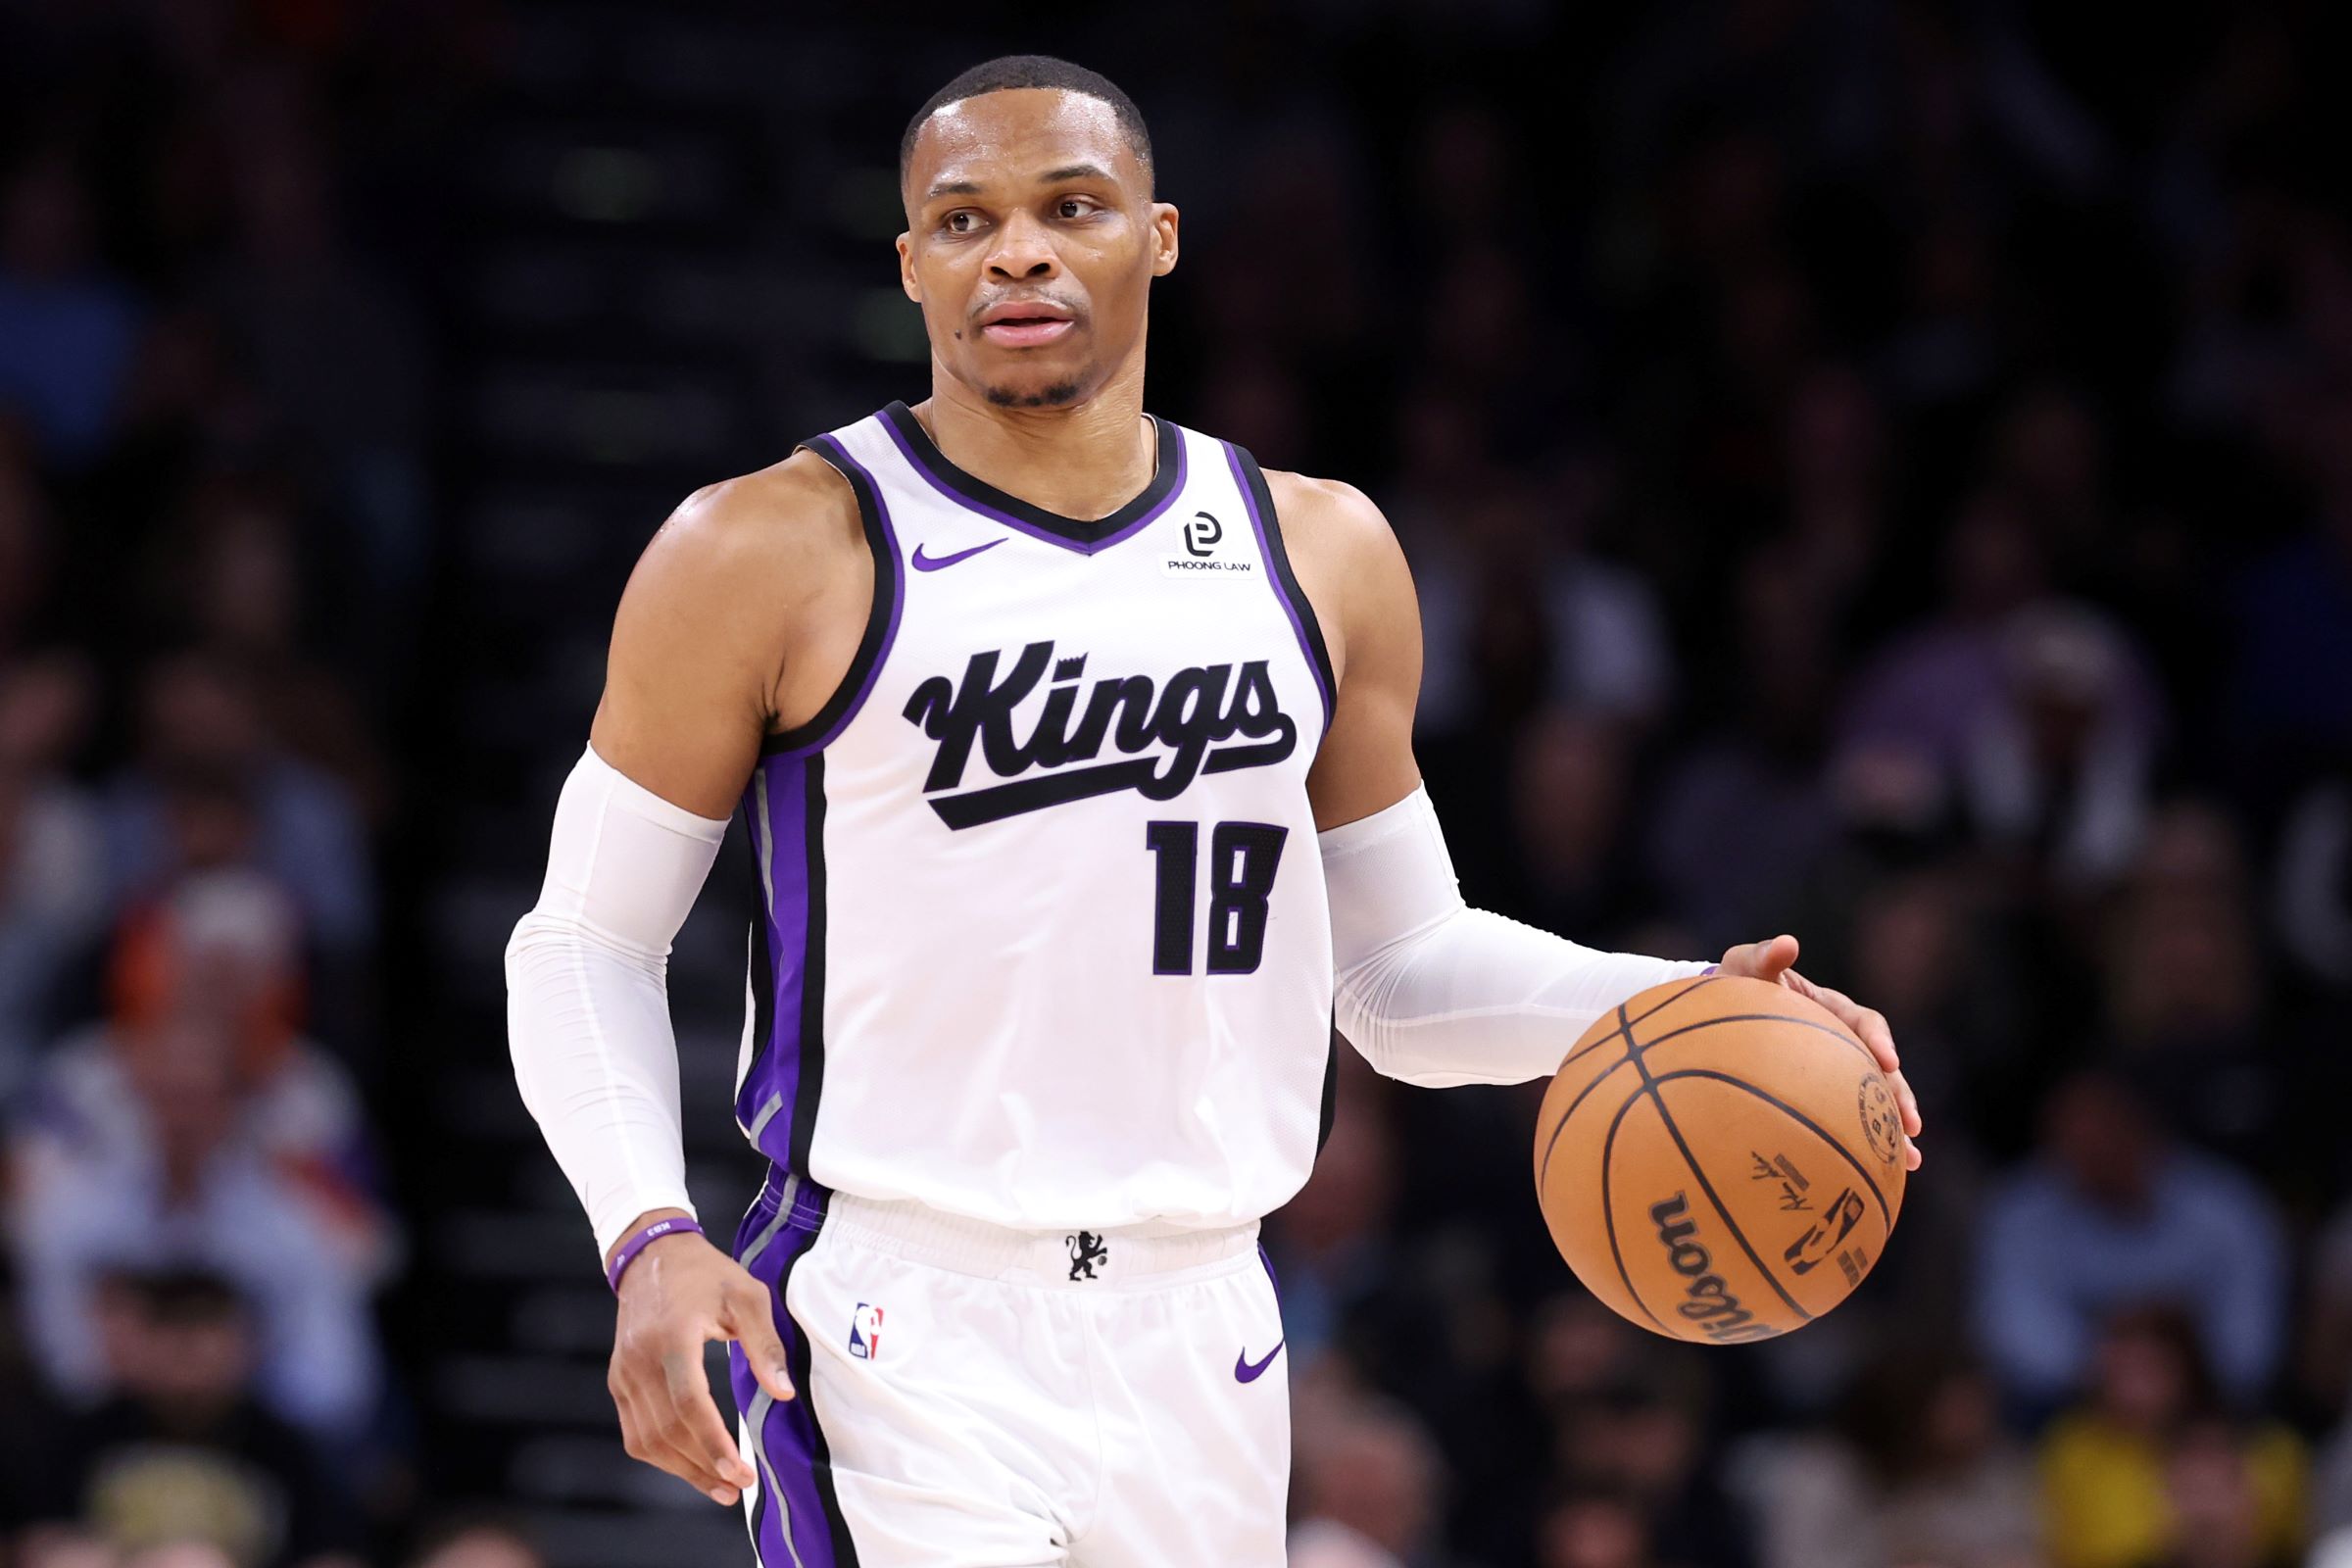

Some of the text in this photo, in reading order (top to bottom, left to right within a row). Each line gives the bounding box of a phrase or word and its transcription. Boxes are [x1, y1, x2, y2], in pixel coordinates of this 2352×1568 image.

[1168, 561, 1250, 571] PHOONG LAW
[903, 640, 1297, 831] Kings
[1147, 820, 1289, 975] 18
